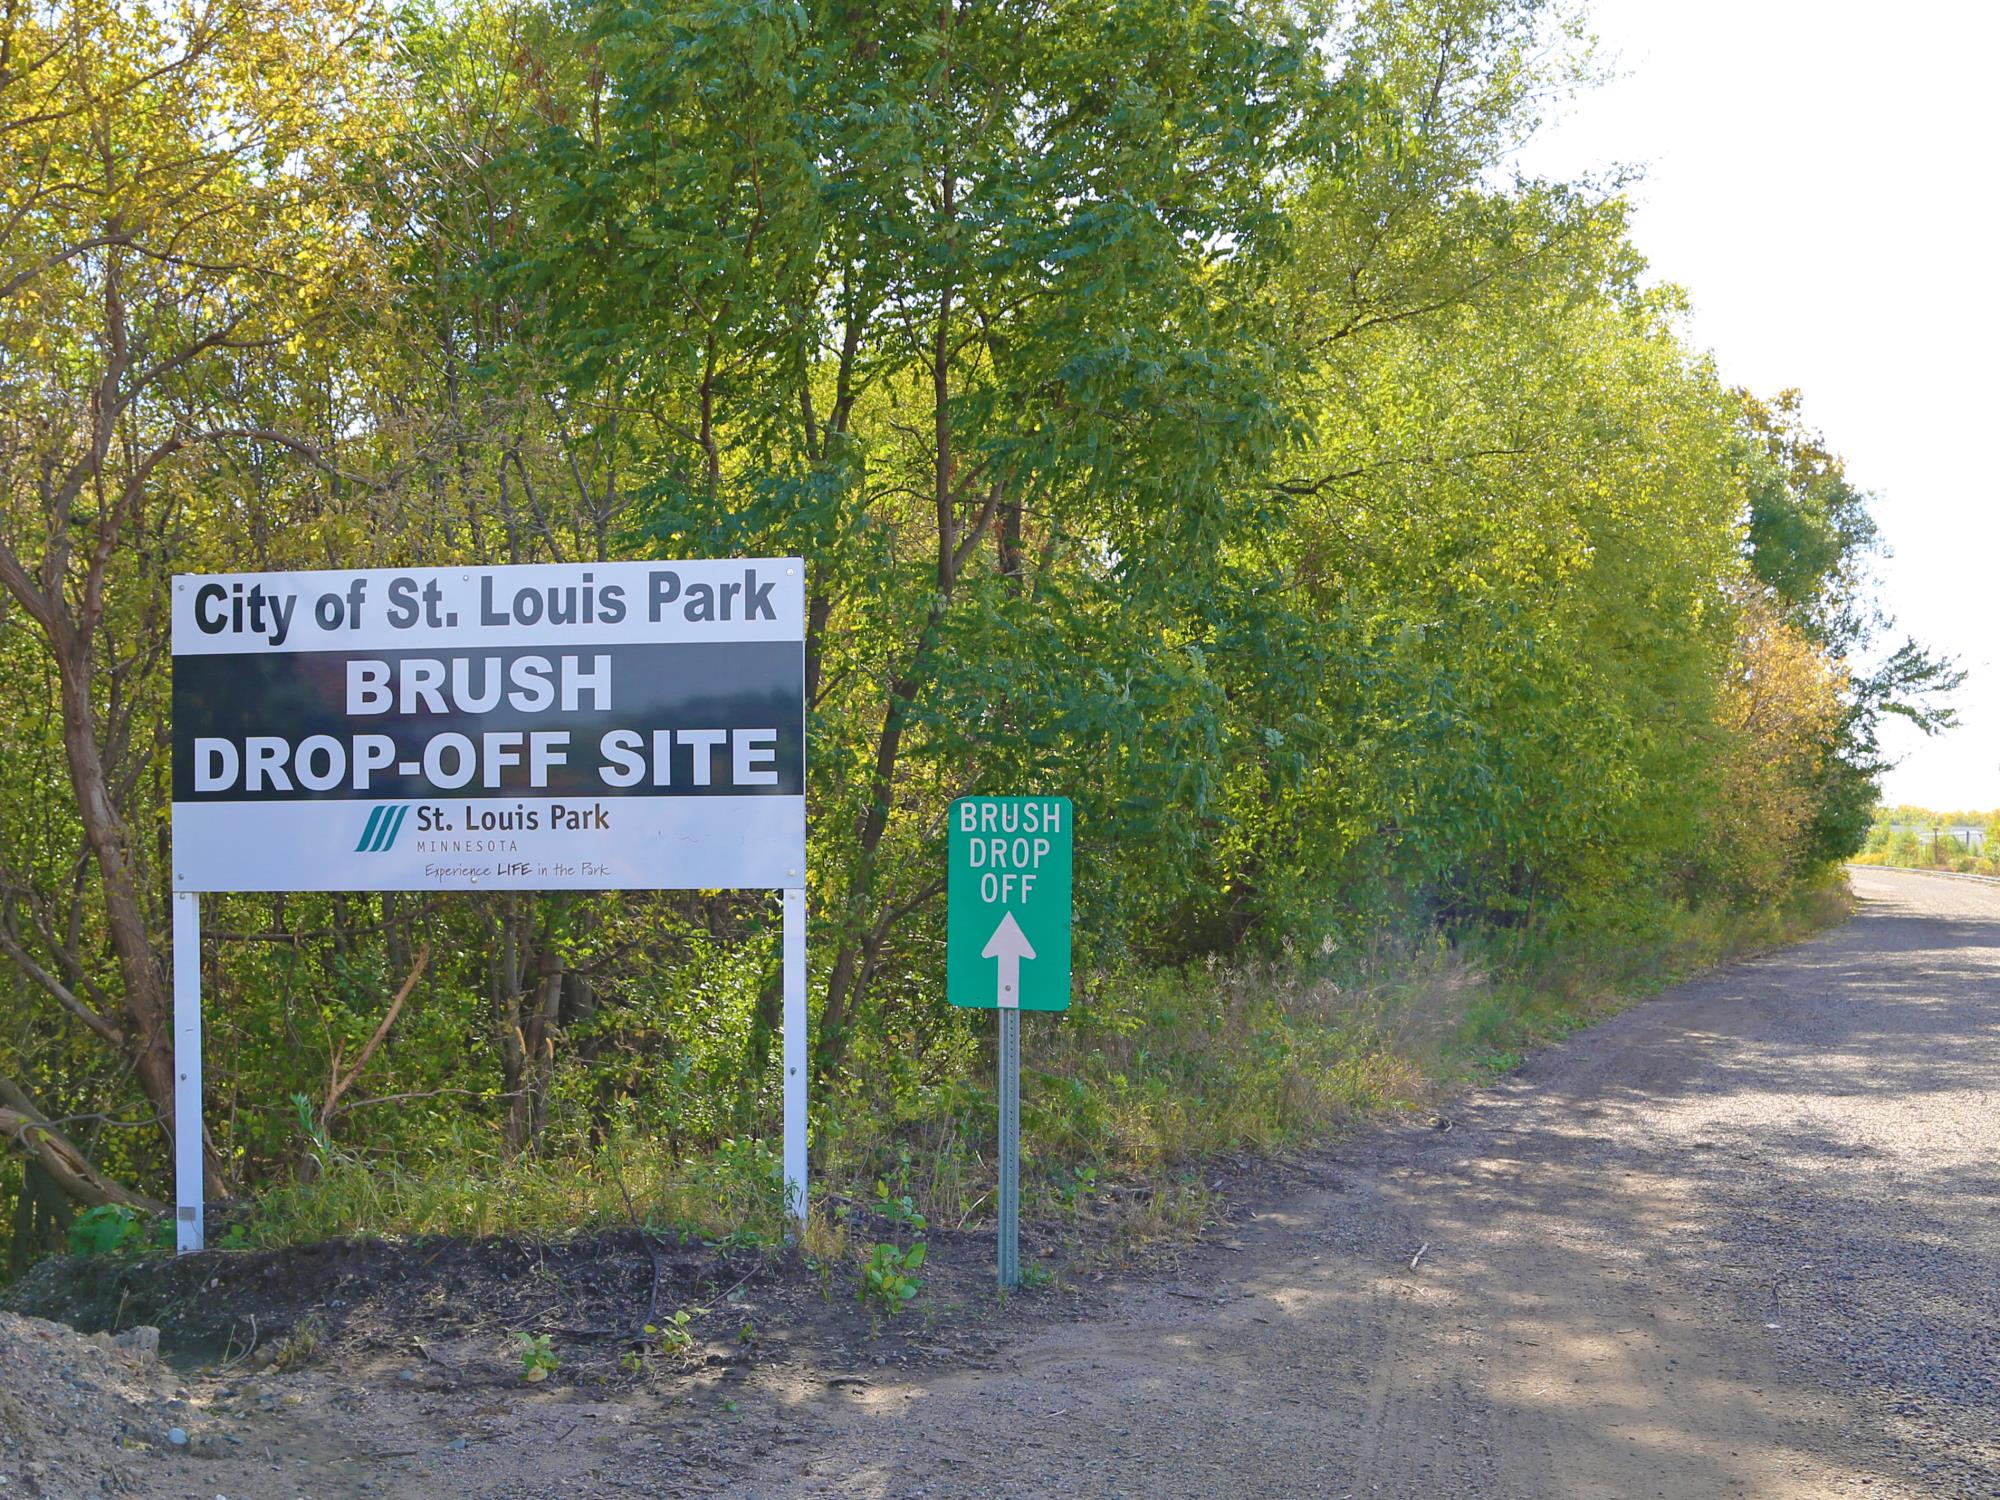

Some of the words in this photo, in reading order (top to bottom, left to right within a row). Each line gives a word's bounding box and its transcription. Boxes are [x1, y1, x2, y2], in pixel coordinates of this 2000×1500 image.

[194, 583, 298, 646] City
[314, 579, 368, 631] of
[387, 577, 458, 629] St.
[480, 572, 627, 626] Louis
[648, 569, 777, 623] Park
[346, 654, 612, 715] BRUSH
[194, 730, 571, 793] DROP-OFF
[598, 727, 778, 788] SITE
[417, 805, 453, 832] St.
[467, 804, 538, 830] Louis
[552, 803, 610, 830] Park
[960, 802, 1060, 833] BRUSH
[417, 840, 518, 853] MINNESOTA
[969, 837, 1050, 868] DROP
[425, 863, 492, 882] Experience
[498, 862, 532, 876] LIFE
[538, 863, 548, 876] in
[554, 863, 576, 876] the
[582, 862, 610, 876] Park
[981, 873, 1037, 904] OFF
